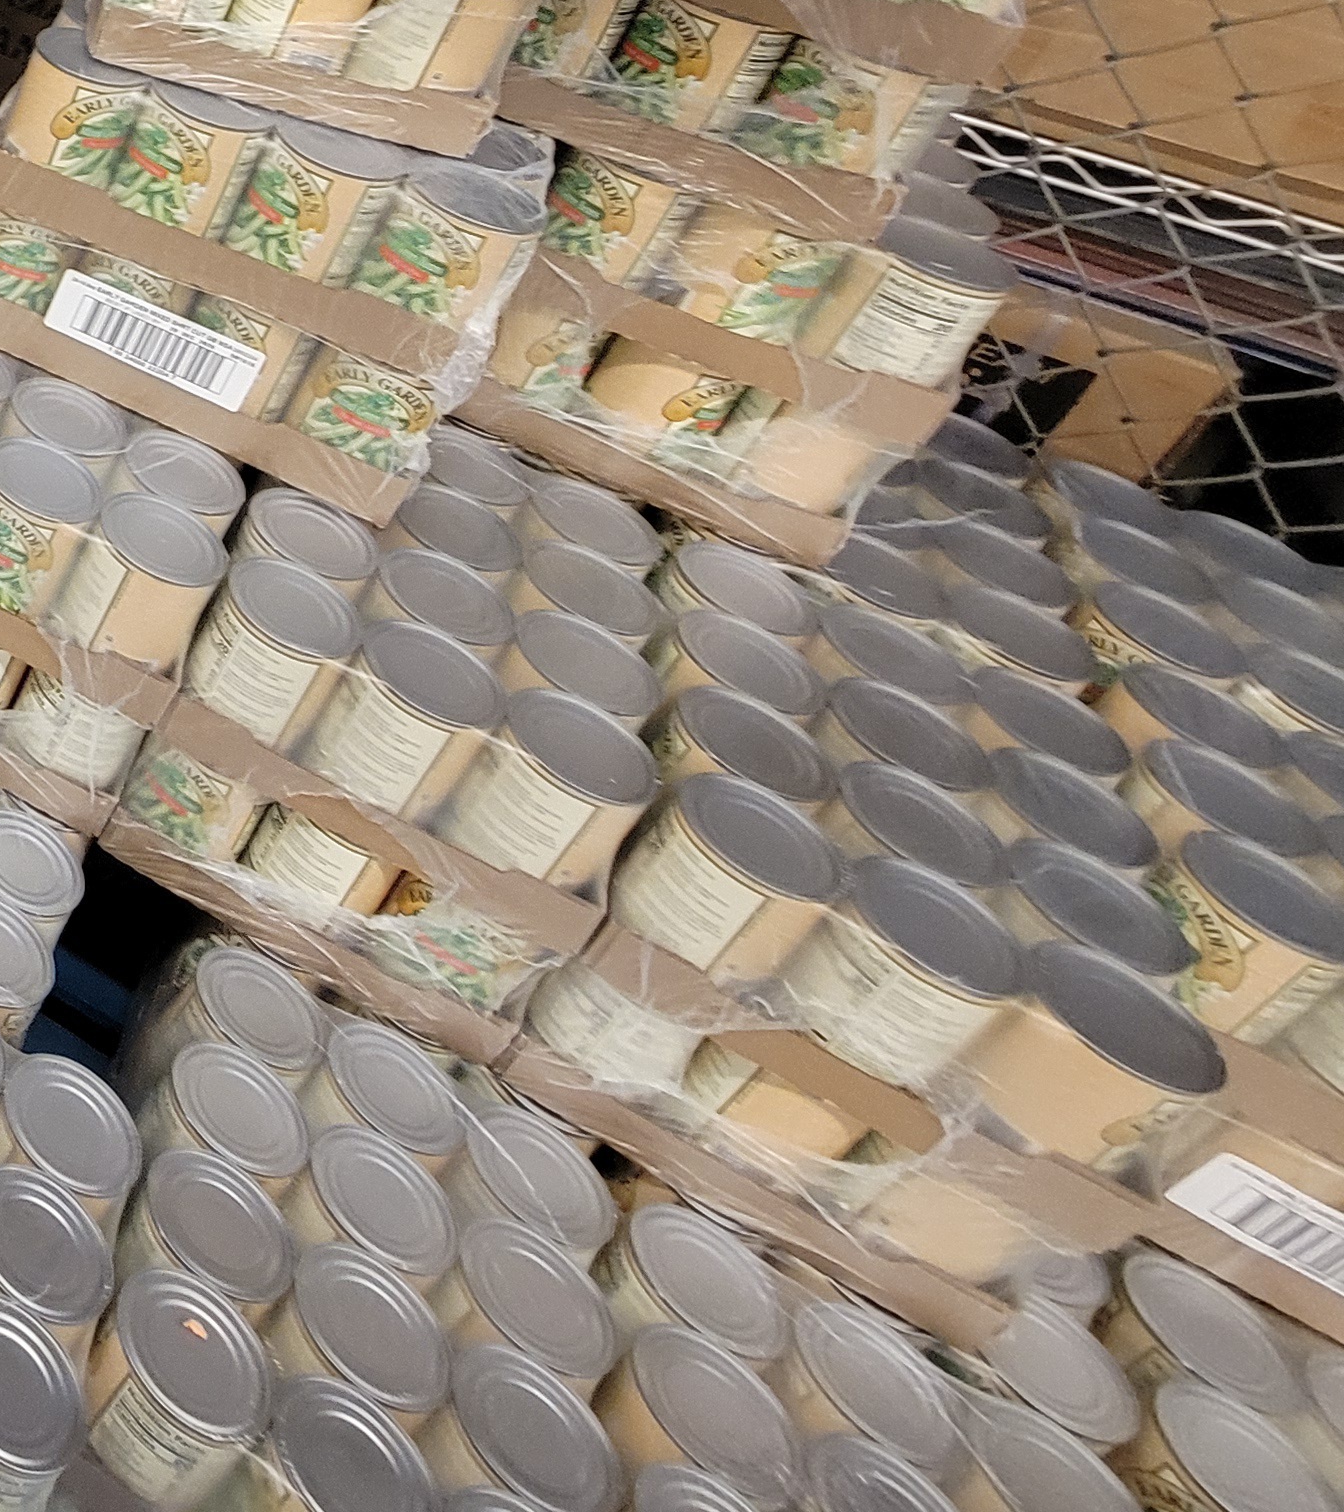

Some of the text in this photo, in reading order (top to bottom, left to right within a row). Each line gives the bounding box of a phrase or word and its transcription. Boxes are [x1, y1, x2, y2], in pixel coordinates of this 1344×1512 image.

[654, 0, 705, 62] GARDEN
[60, 96, 114, 125] EARLY
[156, 111, 204, 170] GARDEN
[275, 149, 320, 216] GARDEN
[580, 157, 629, 220] GARDEN
[324, 360, 429, 423] EARLY GARDEN
[1175, 882, 1234, 967] GARDEN
